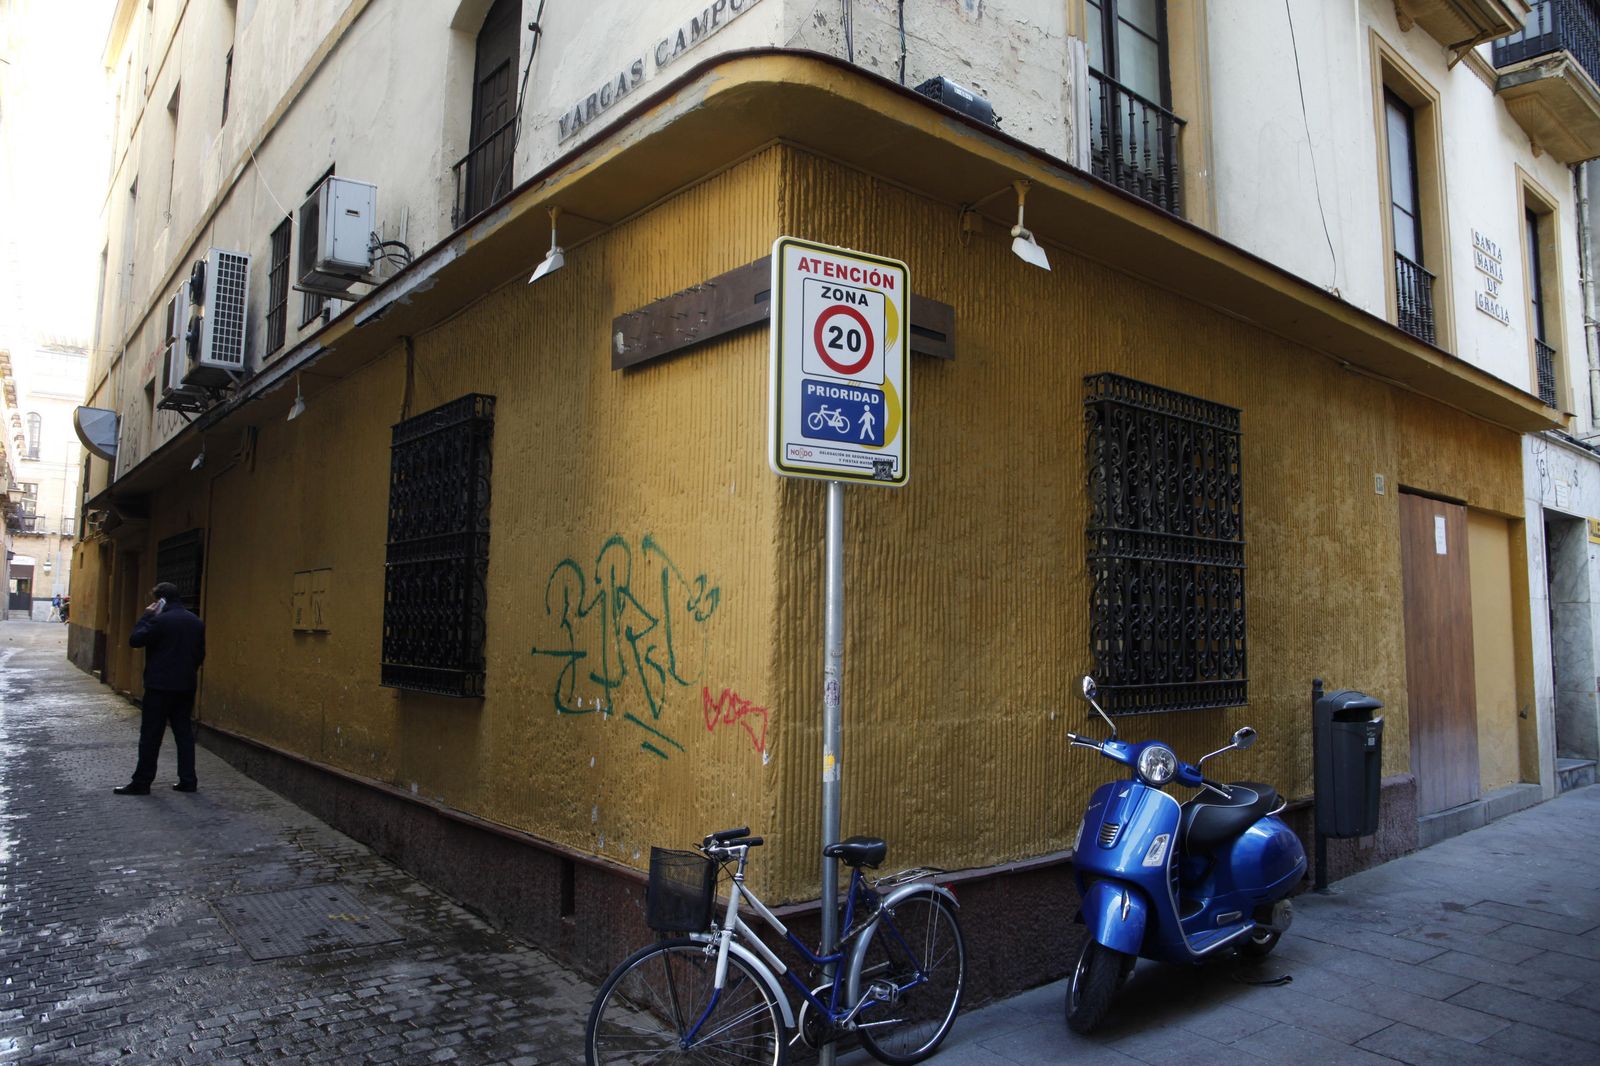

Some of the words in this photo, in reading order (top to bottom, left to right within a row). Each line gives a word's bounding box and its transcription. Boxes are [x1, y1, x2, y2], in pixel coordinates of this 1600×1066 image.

[558, 58, 643, 137] VARGAS
[654, 0, 757, 67] CAMPU
[1475, 231, 1503, 261] SANTA
[797, 256, 895, 290] ATENCIÓN
[1486, 278, 1499, 296] DE
[820, 285, 869, 307] ZONA
[1478, 294, 1510, 323] GRACIA
[828, 325, 861, 353] 20
[807, 384, 880, 404] PRIORIDAD
